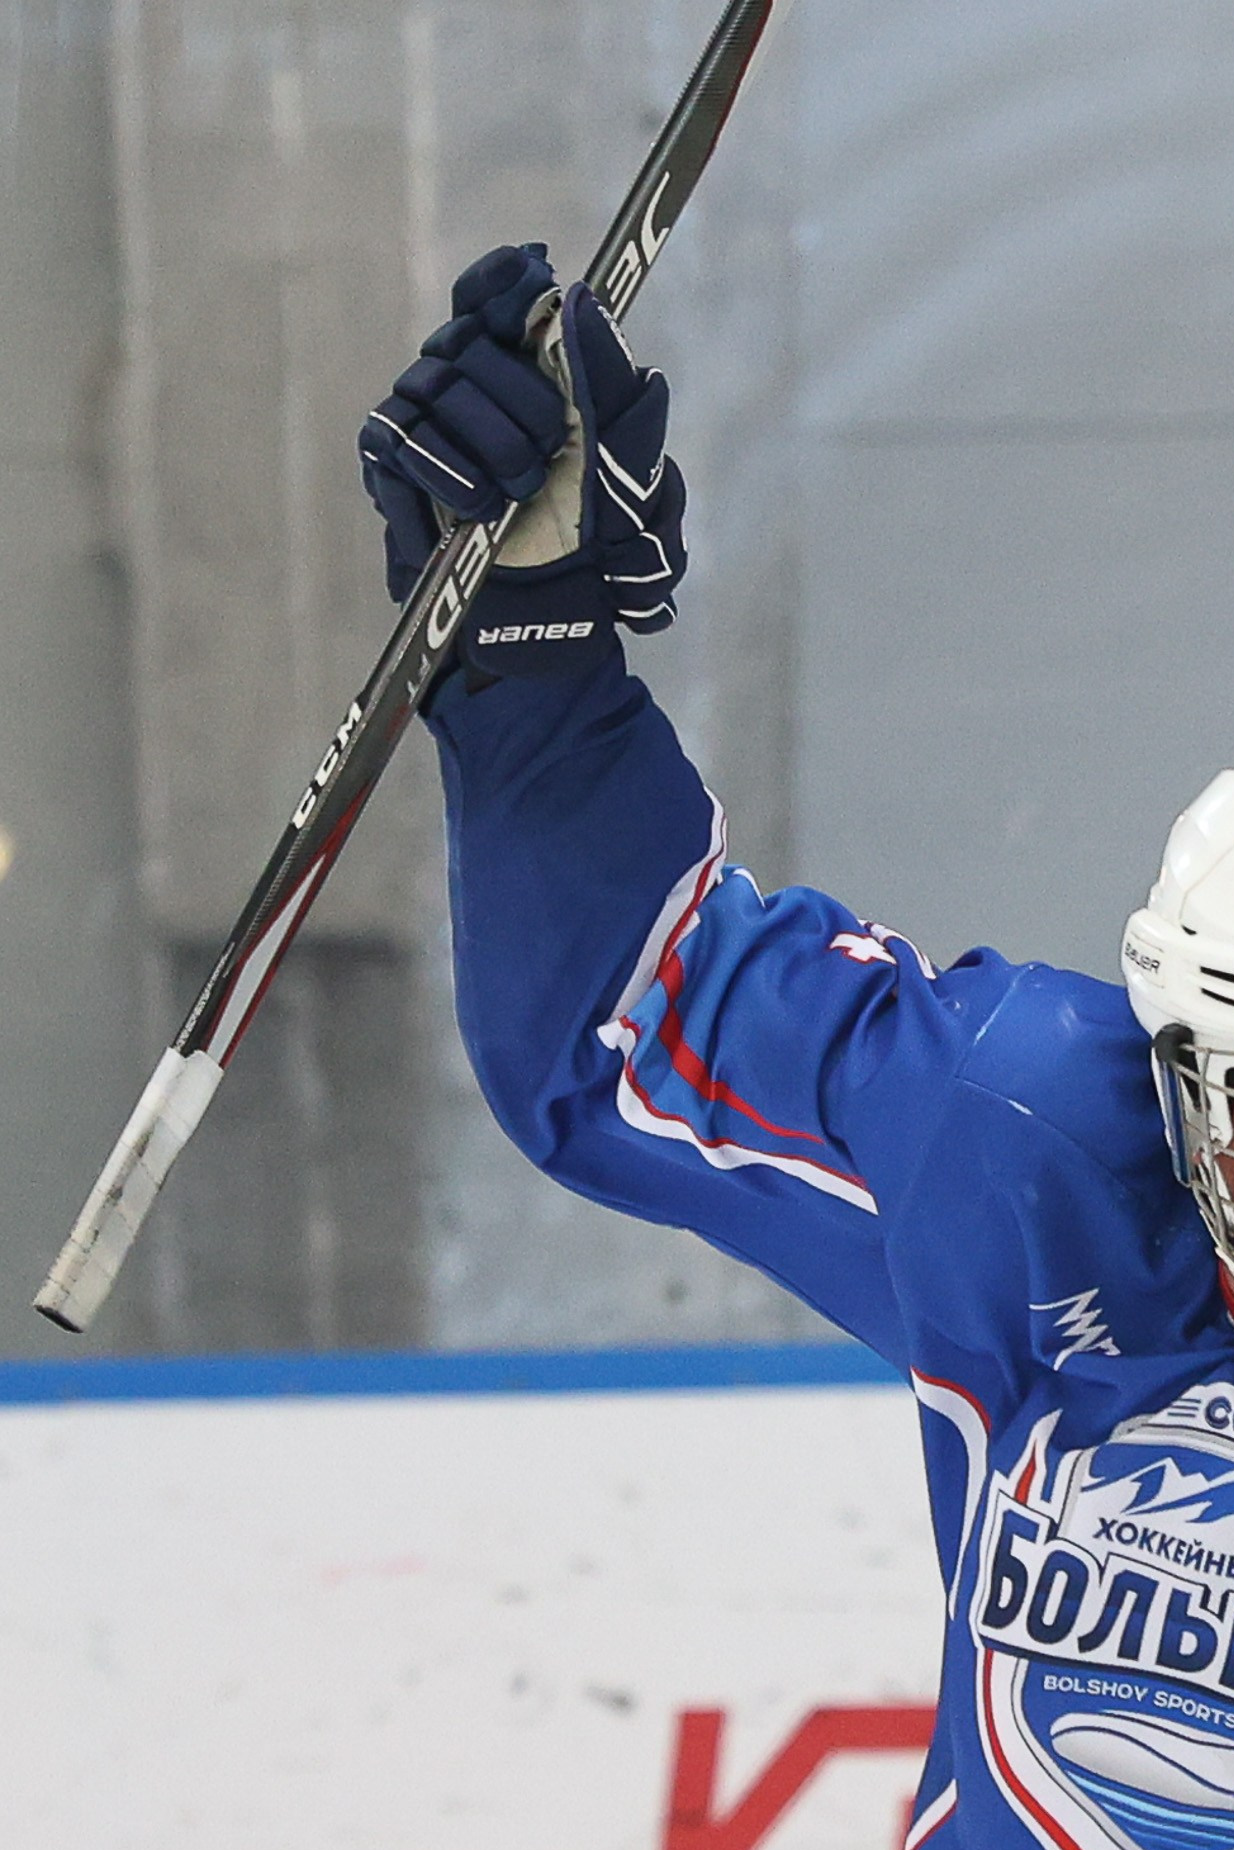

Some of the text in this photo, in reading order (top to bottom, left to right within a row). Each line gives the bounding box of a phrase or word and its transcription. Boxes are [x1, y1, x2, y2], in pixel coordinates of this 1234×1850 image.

[477, 620, 595, 645] BAUER
[292, 700, 363, 830] CCM
[1043, 1674, 1149, 1702] BOLSHOY
